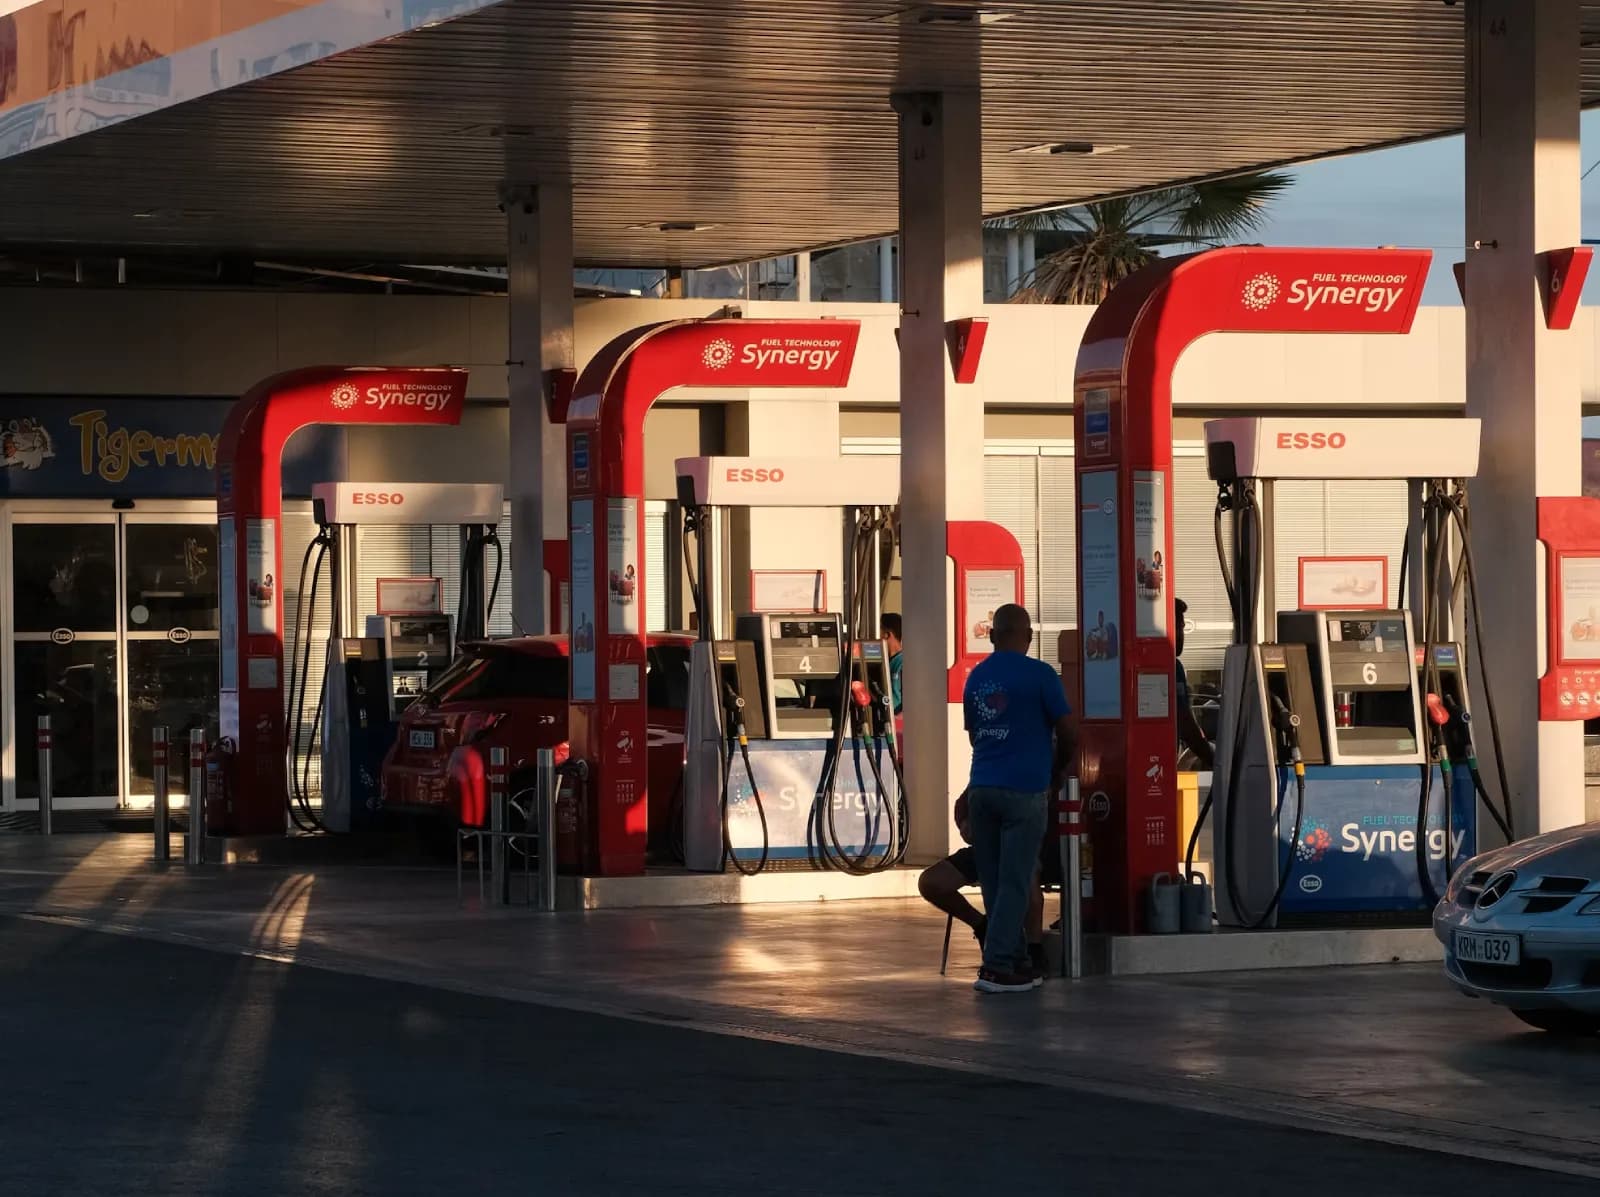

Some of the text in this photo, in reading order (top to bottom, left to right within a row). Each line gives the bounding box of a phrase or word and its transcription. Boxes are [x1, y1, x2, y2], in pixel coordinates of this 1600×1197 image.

[1312, 273, 1407, 284] FUEL TECHNOLOGY
[1551, 269, 1560, 293] 6
[1287, 279, 1404, 312] Synergy
[761, 338, 842, 347] FUEL TECHNOLOGY
[741, 344, 839, 370] Synergy
[365, 387, 451, 411] Synergy
[69, 410, 219, 483] Tigerm
[1277, 431, 1346, 449] ESSO
[726, 468, 785, 482] ESSO
[352, 492, 404, 505] ESSO
[55, 632, 71, 640] Esso
[172, 631, 188, 639] Esso
[416, 651, 429, 666] 2
[799, 656, 812, 673] 4
[1362, 662, 1378, 685] 6
[1362, 815, 1389, 825] FUEL
[1341, 823, 1466, 861] Synegy
[1303, 878, 1320, 888] Esso
[1458, 936, 1477, 960] KRM
[1484, 940, 1511, 960] 039
